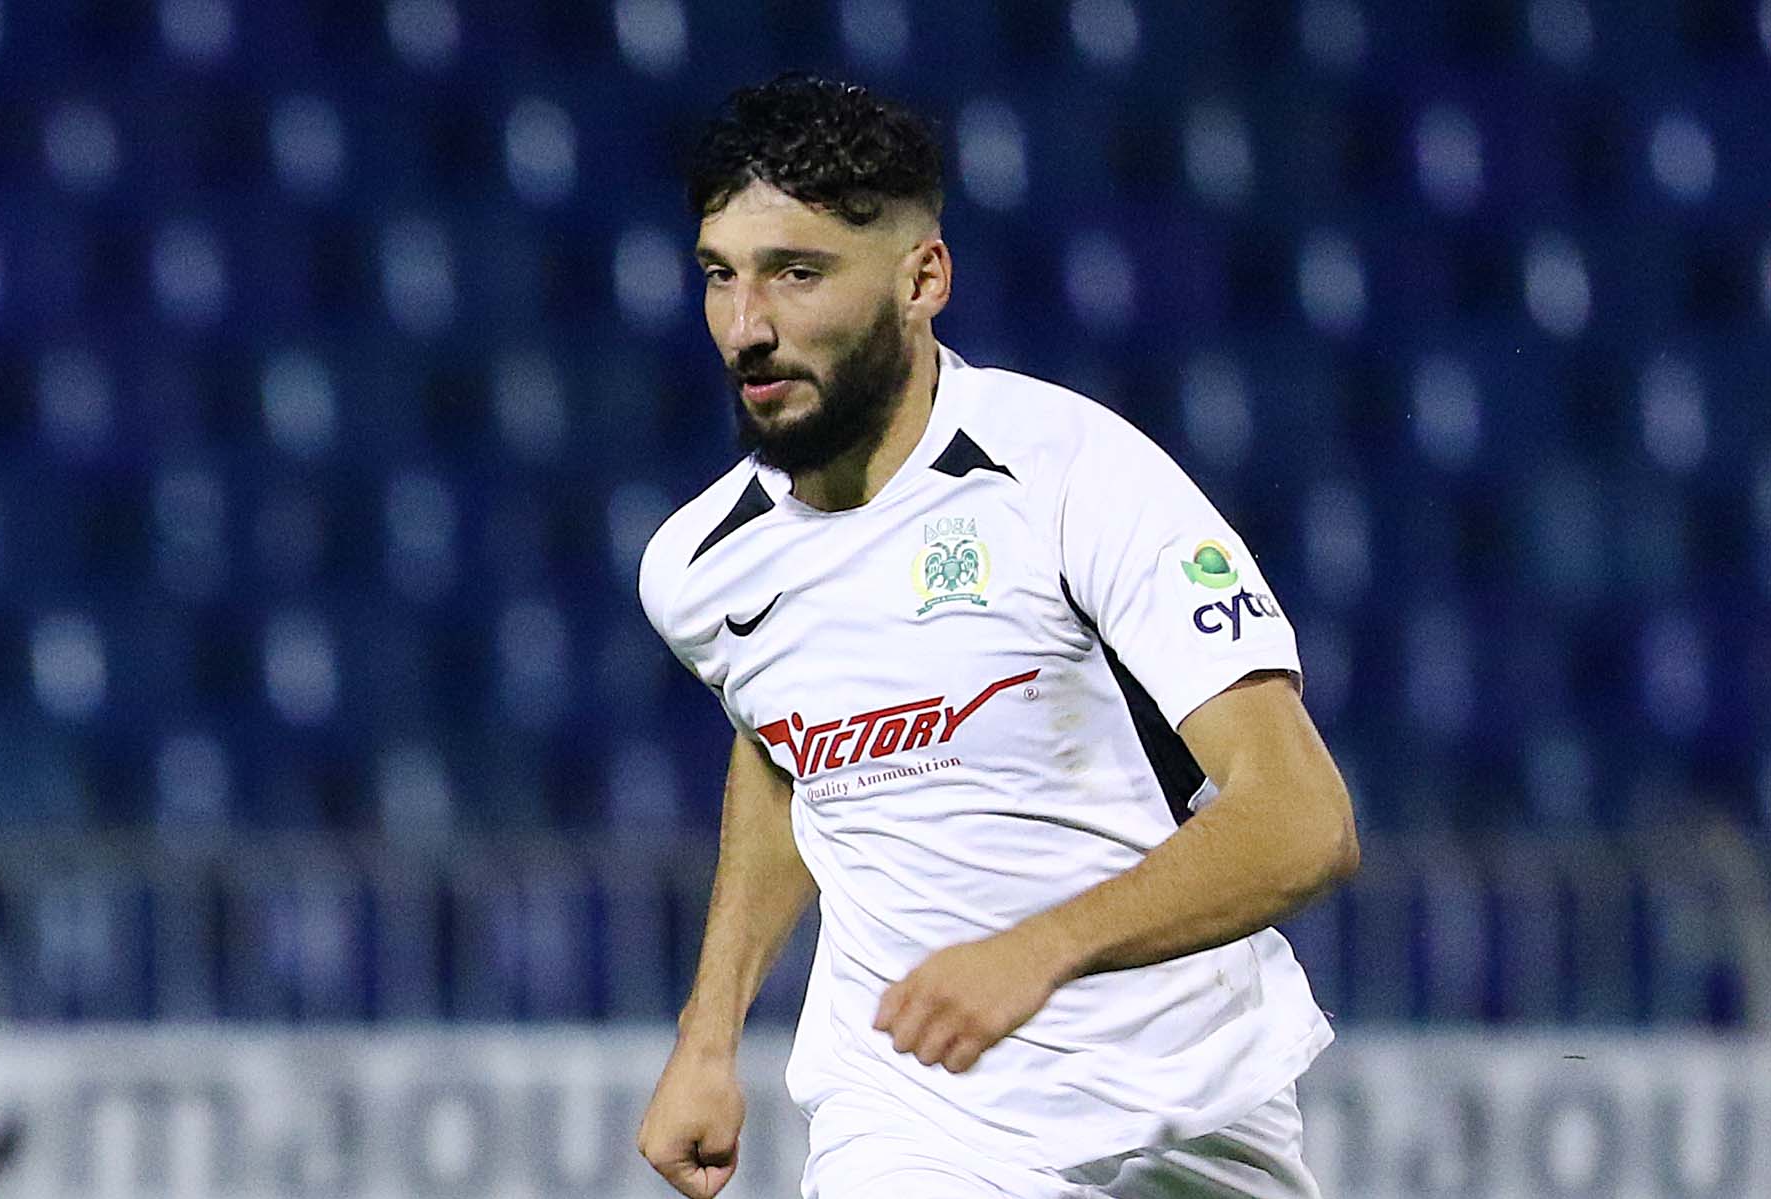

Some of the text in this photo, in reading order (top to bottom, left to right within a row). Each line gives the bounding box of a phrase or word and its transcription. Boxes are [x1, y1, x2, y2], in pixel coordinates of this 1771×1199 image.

[756, 668, 1041, 778] VICTORY
[806, 756, 962, 802] Quality Ammunition
